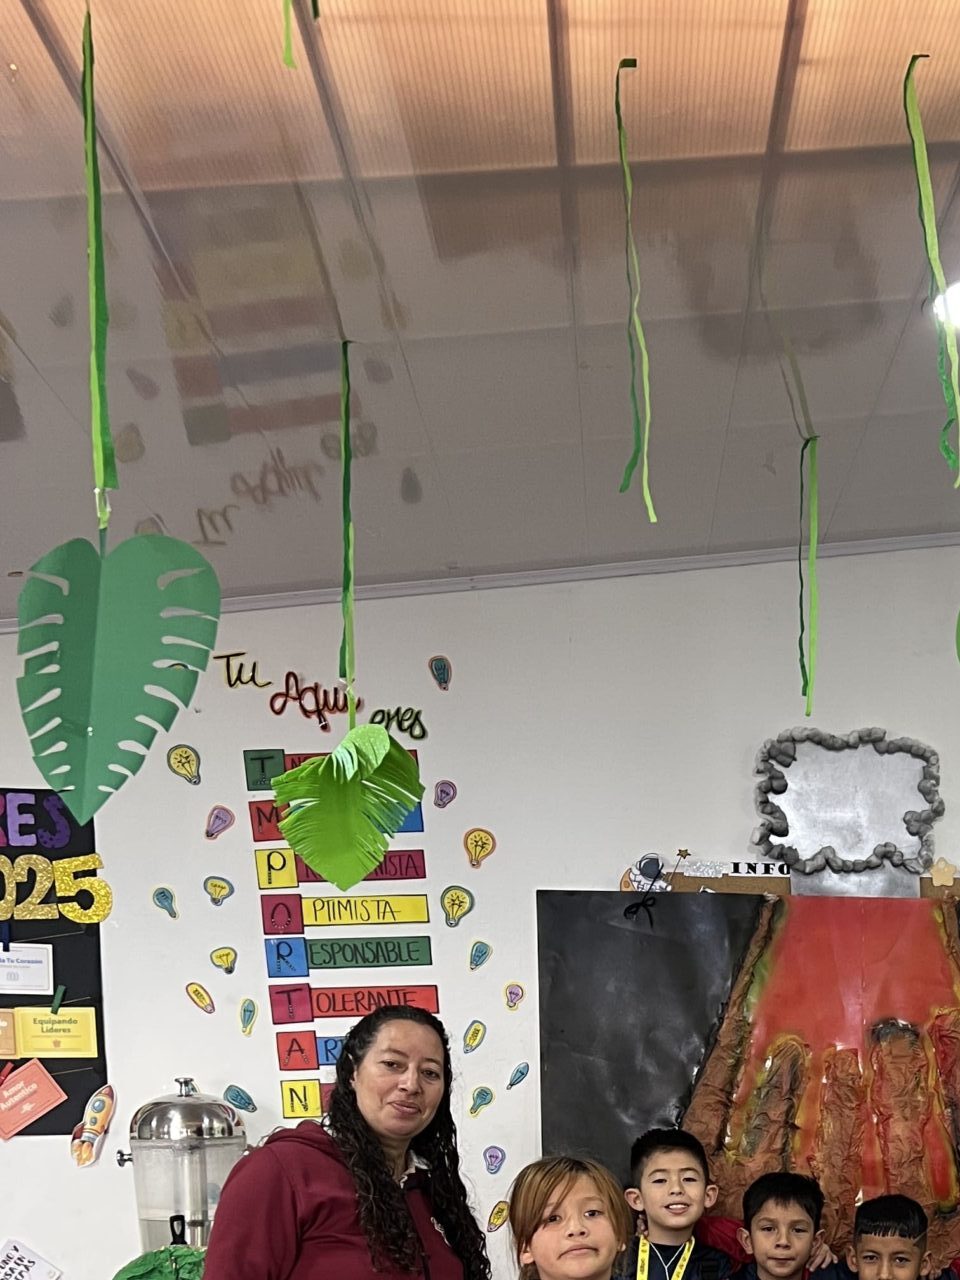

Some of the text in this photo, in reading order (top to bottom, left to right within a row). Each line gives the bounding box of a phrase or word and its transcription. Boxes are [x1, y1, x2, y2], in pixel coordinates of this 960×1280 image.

[213, 652, 272, 688] Tu
[0, 792, 71, 848] ES
[33, 1017, 78, 1026] Equipando
[3, 1081, 25, 1098] Amor
